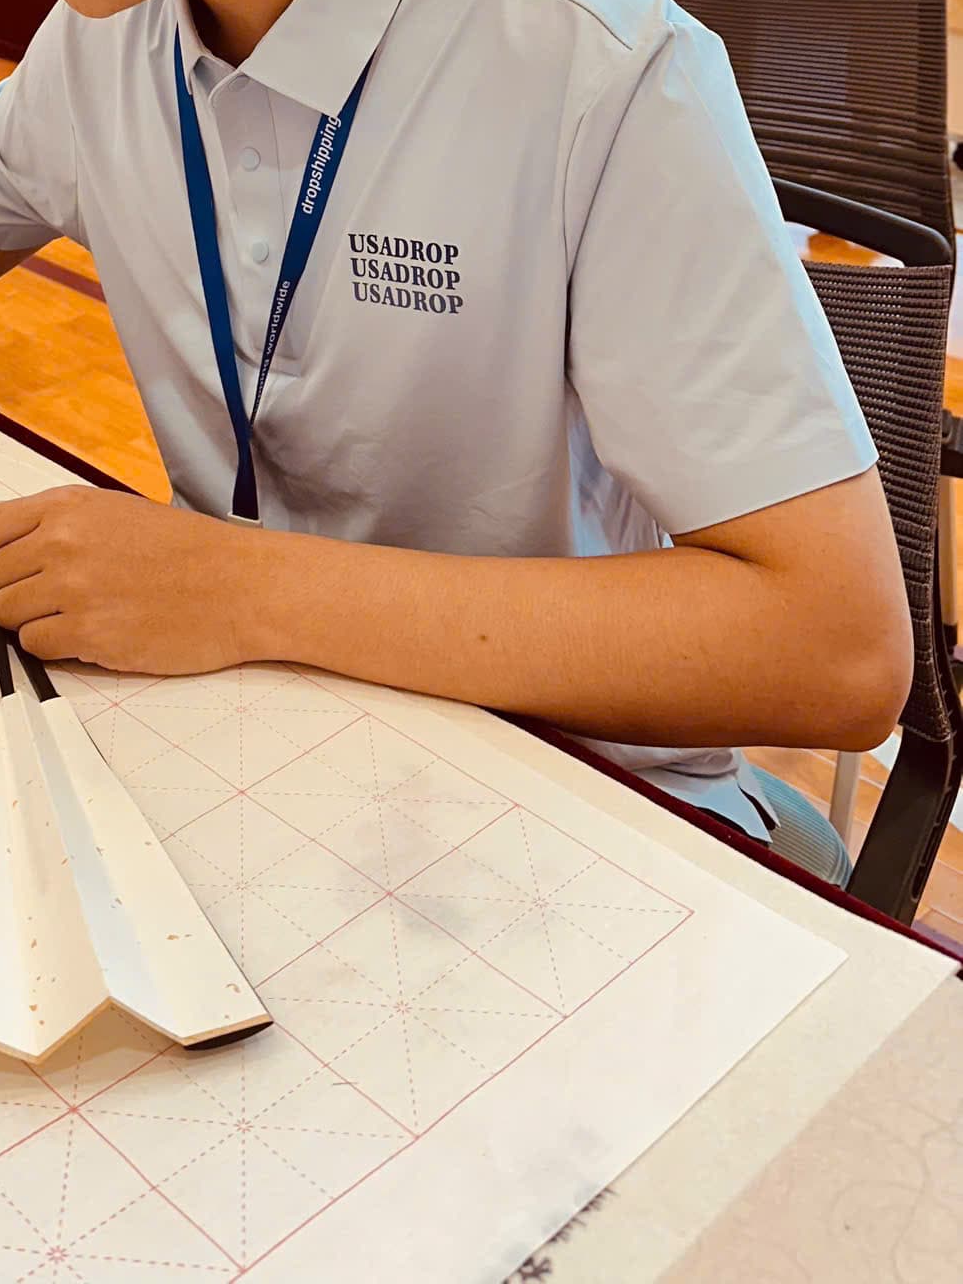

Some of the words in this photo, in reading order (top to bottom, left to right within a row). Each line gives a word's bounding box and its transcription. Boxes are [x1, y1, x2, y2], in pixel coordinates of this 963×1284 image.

[301, 116, 341, 215] dropshipping
[348, 233, 459, 265] USADROP
[350, 257, 460, 290] USADROP
[352, 281, 464, 314] USADROP
[266, 280, 291, 356] worldwide
